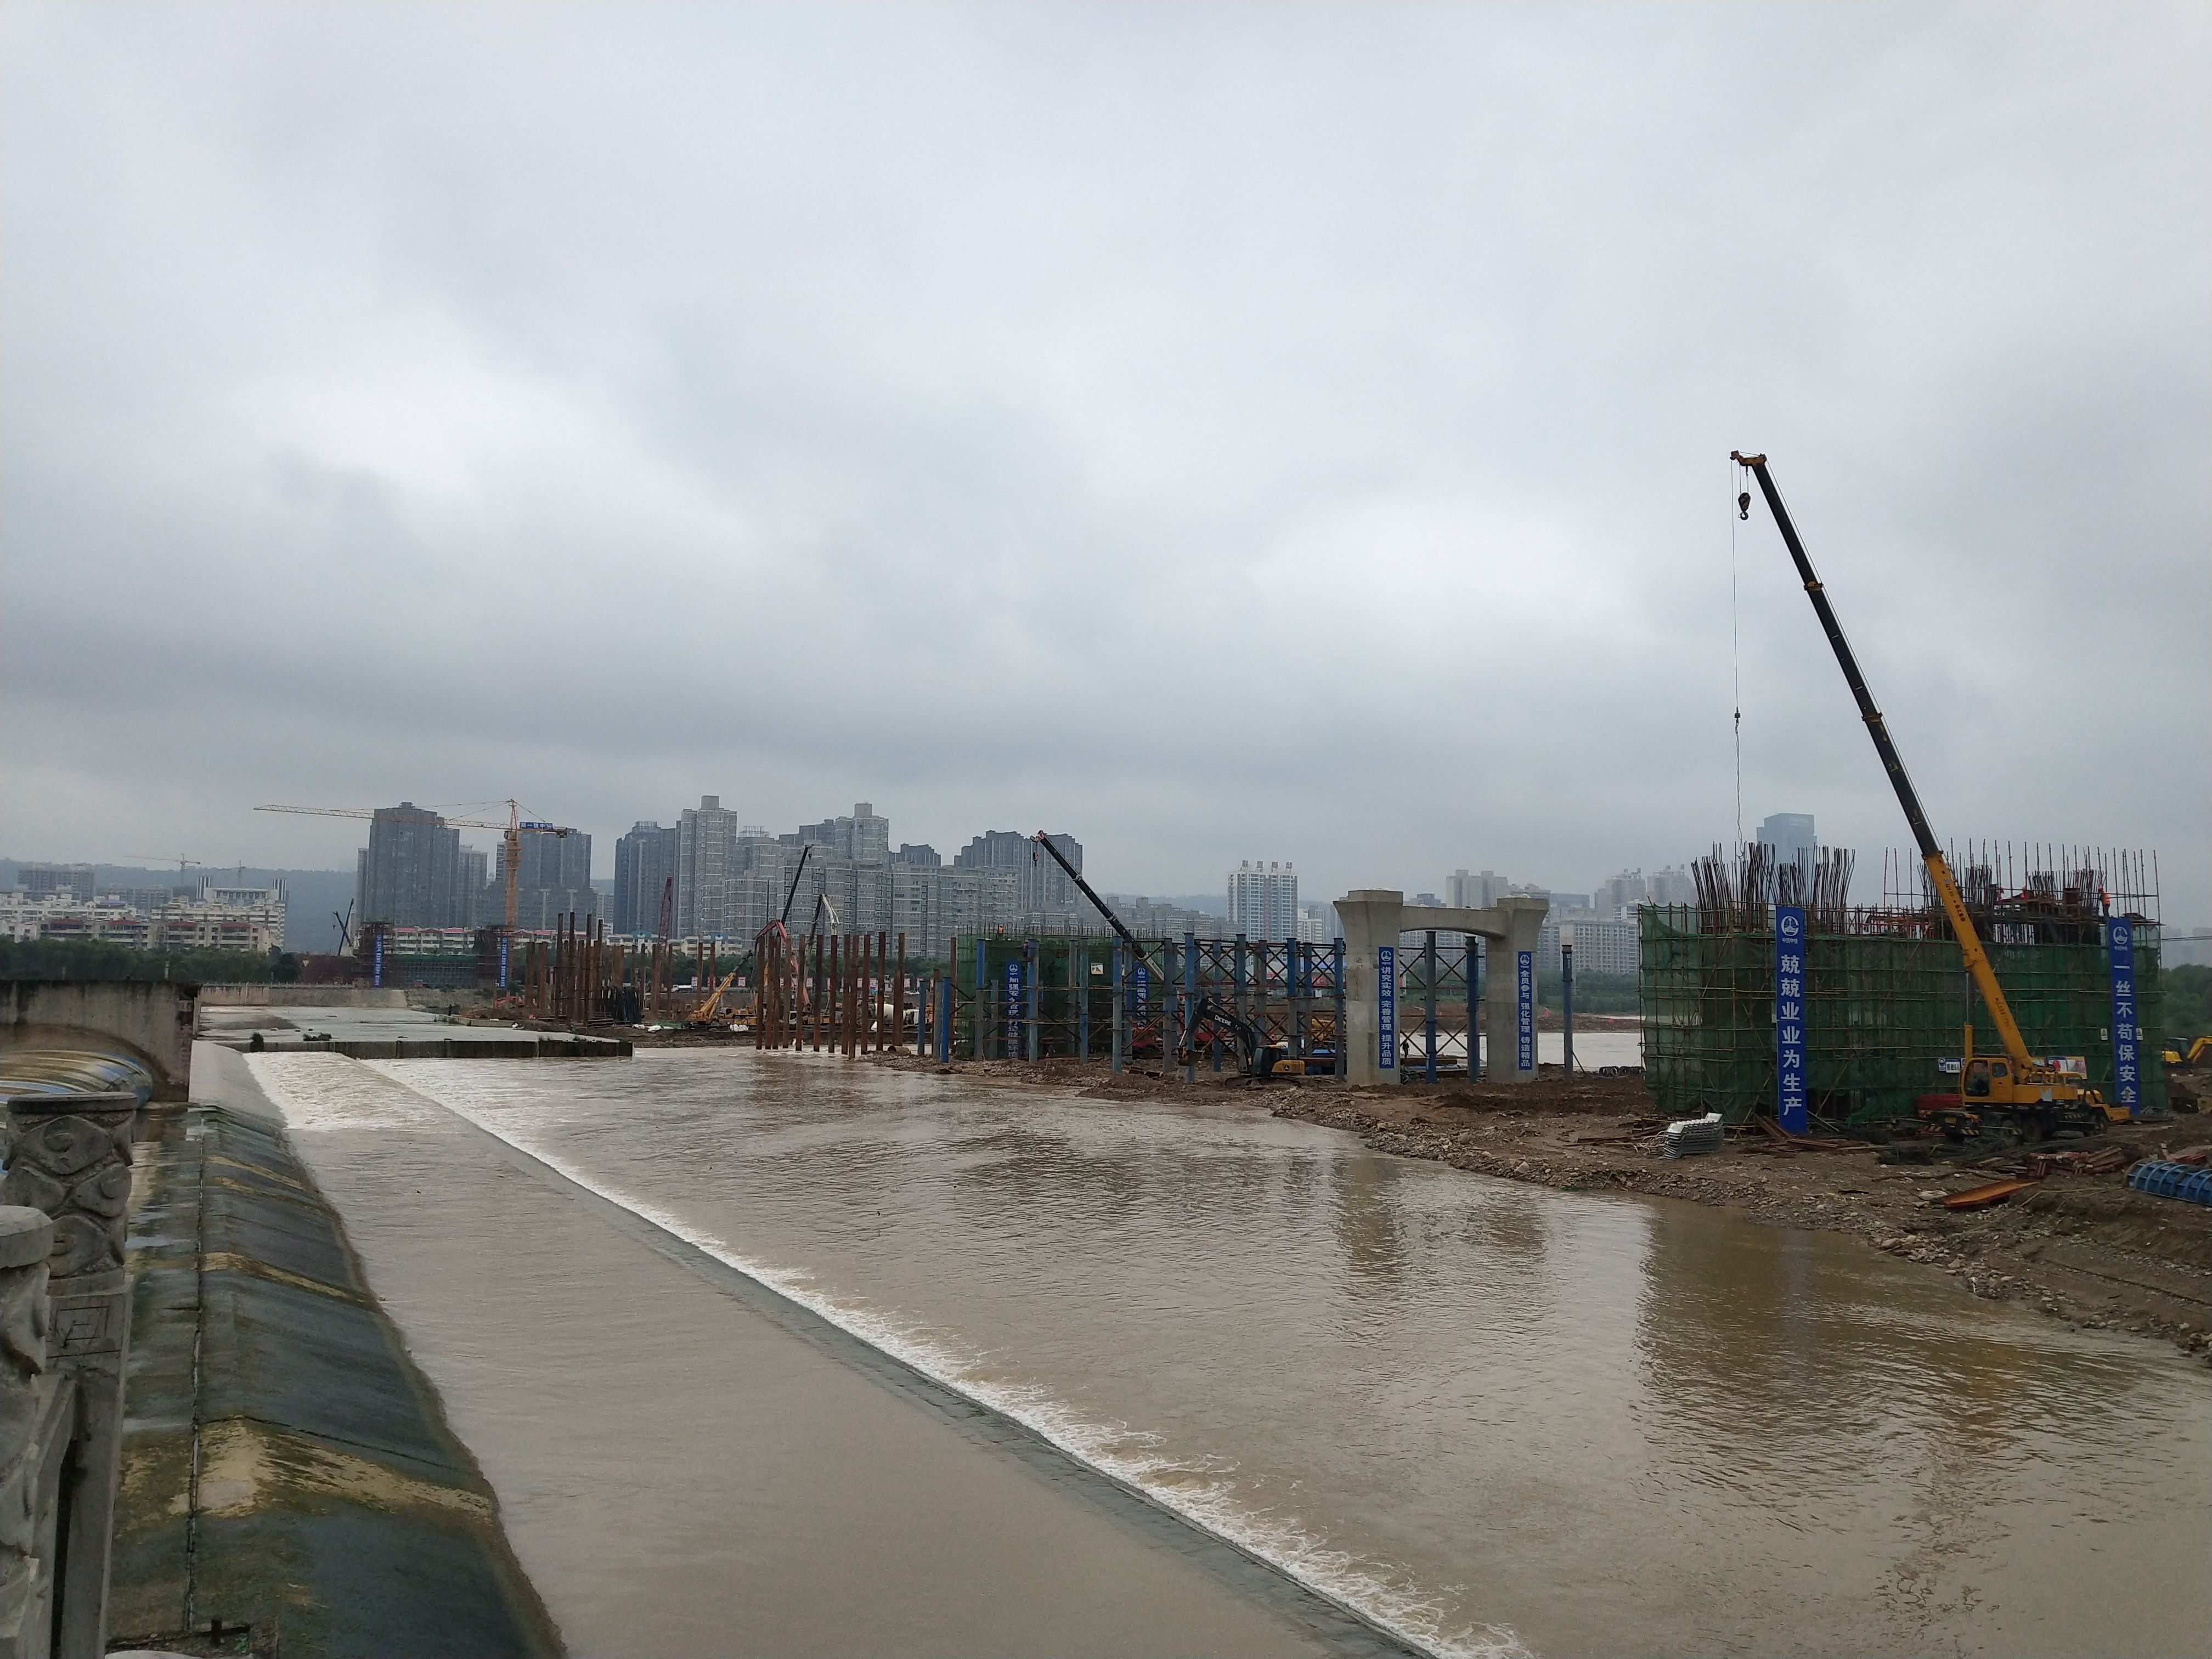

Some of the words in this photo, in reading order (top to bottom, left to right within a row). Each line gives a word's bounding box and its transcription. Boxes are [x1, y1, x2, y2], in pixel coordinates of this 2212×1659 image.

[1381, 966, 1392, 997] 讲究实效
[1520, 970, 1530, 1000] 全员参与
[1214, 1014, 1232, 1026] DEERE
[1381, 1000, 1392, 1031] 完善管理
[1521, 1002, 1531, 1033] 强化管理
[1381, 1034, 1392, 1065] 提升品质
[1780, 954, 1802, 1116] 兢兢业业为生产
[2114, 965, 2137, 1103] 一丝不苟保安全
